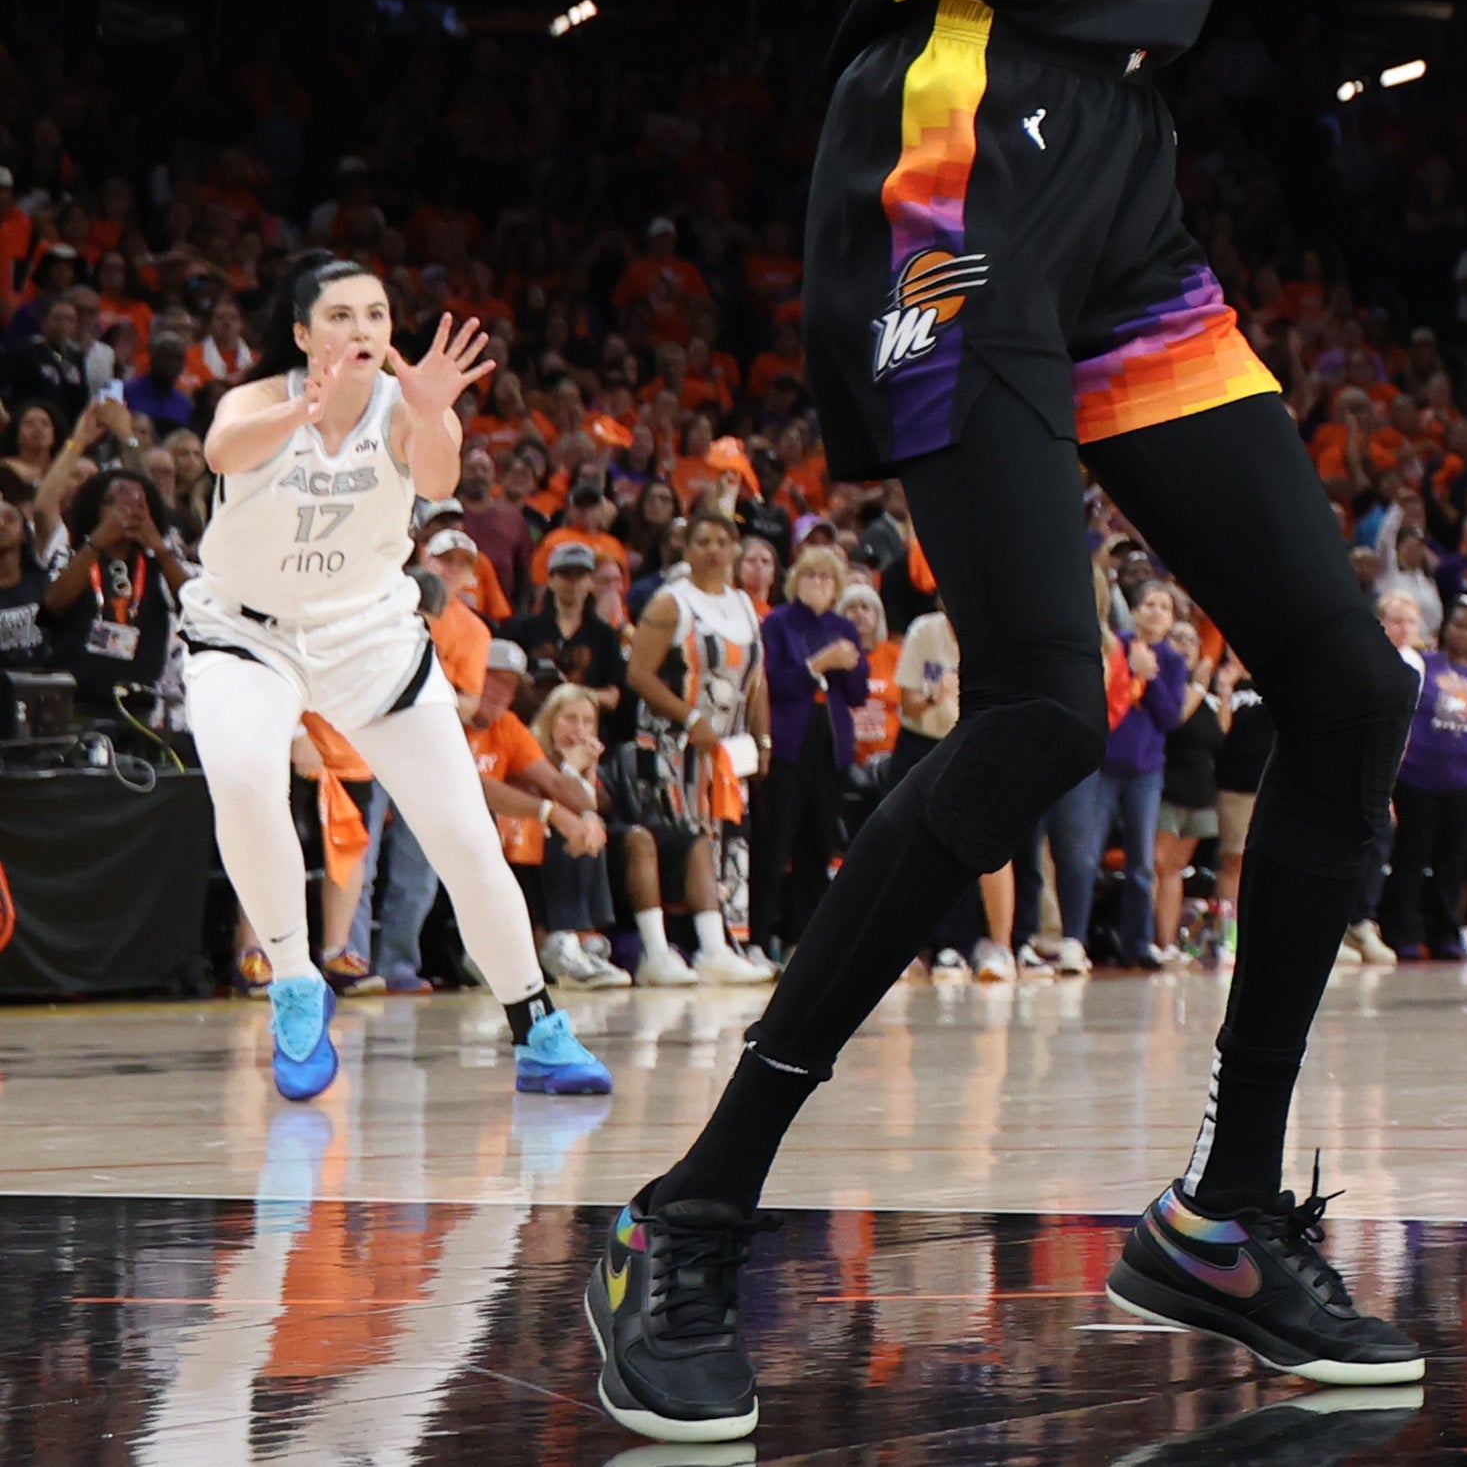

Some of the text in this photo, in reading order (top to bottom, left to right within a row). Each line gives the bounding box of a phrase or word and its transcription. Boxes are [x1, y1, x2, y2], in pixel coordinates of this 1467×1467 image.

[355, 439, 379, 453] ally
[279, 465, 380, 496] ACES
[294, 503, 355, 544] 17
